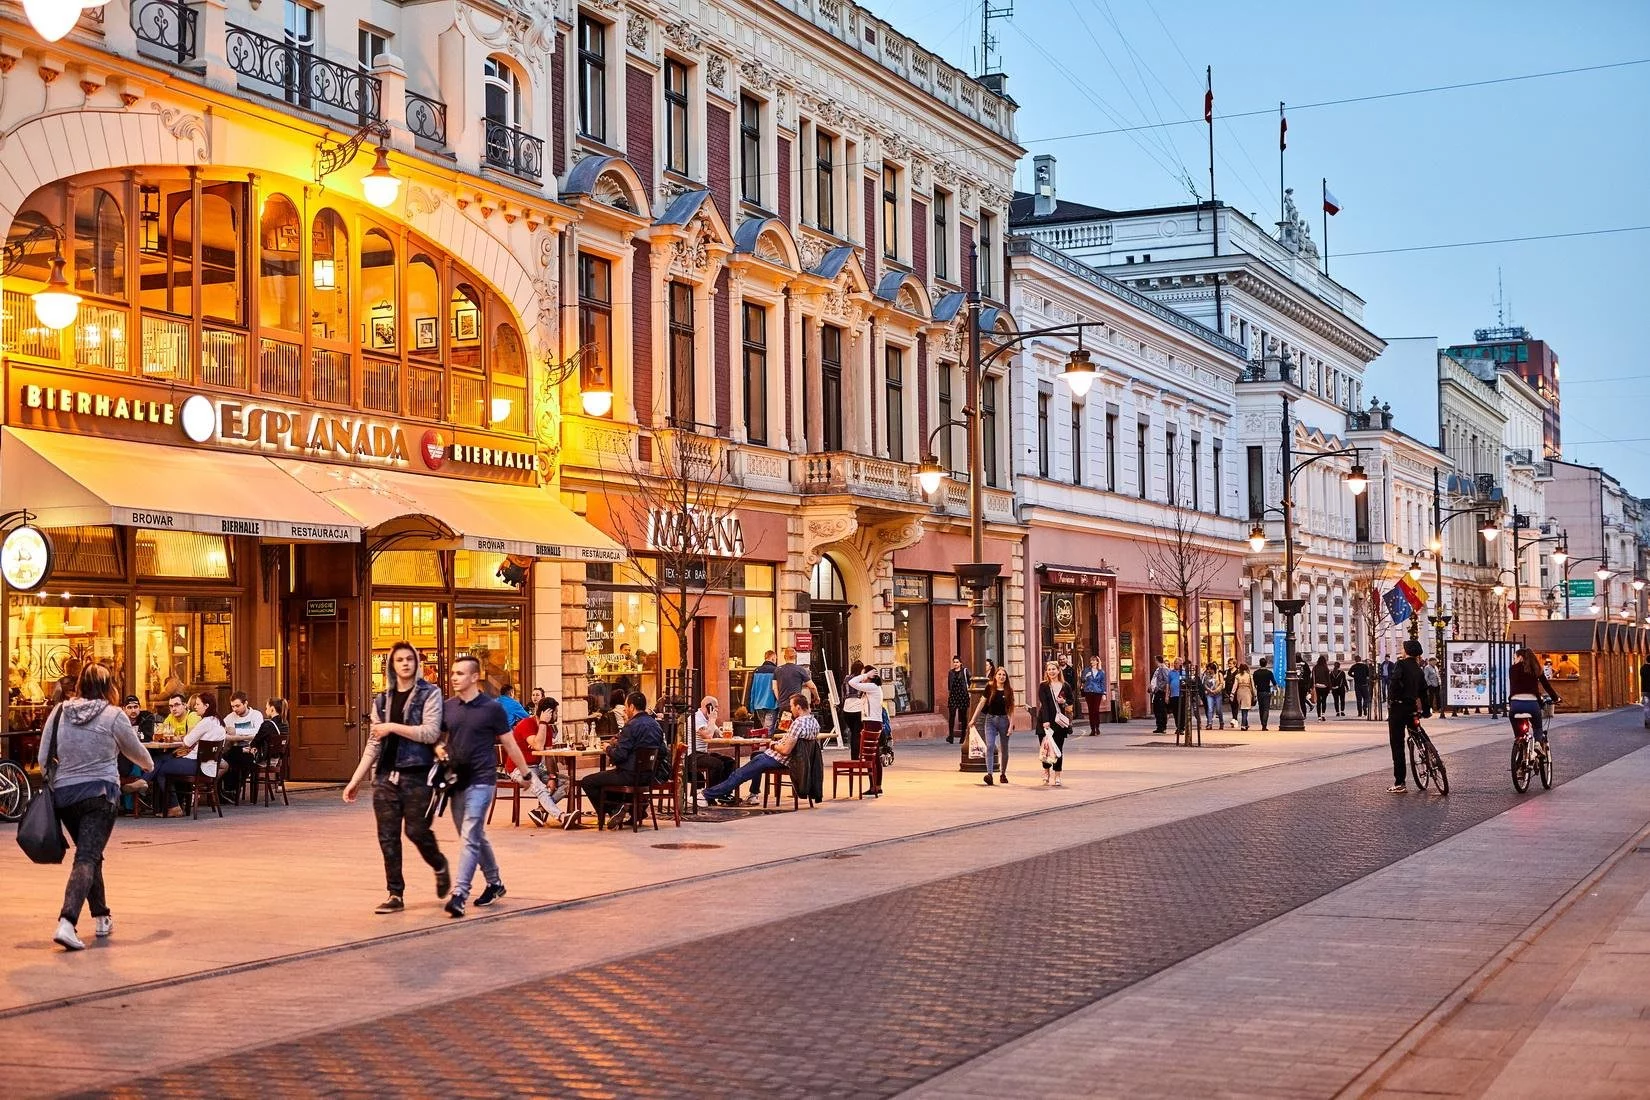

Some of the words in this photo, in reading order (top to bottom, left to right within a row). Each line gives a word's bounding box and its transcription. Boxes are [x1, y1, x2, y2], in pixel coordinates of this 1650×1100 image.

[22, 384, 174, 425] BIERHALLE
[218, 403, 410, 461] ESPLANADA
[452, 443, 540, 471] BIERHALLE
[132, 512, 174, 526] BROWAR
[221, 519, 260, 535] BIERHALLE
[291, 526, 349, 538] RESTAURACJA
[477, 540, 505, 550] BROWAR
[535, 544, 561, 557] BIERHALLE
[581, 548, 621, 560] RESTAURACJA
[665, 567, 692, 579] TEX-EX
[694, 569, 707, 580] BAR
